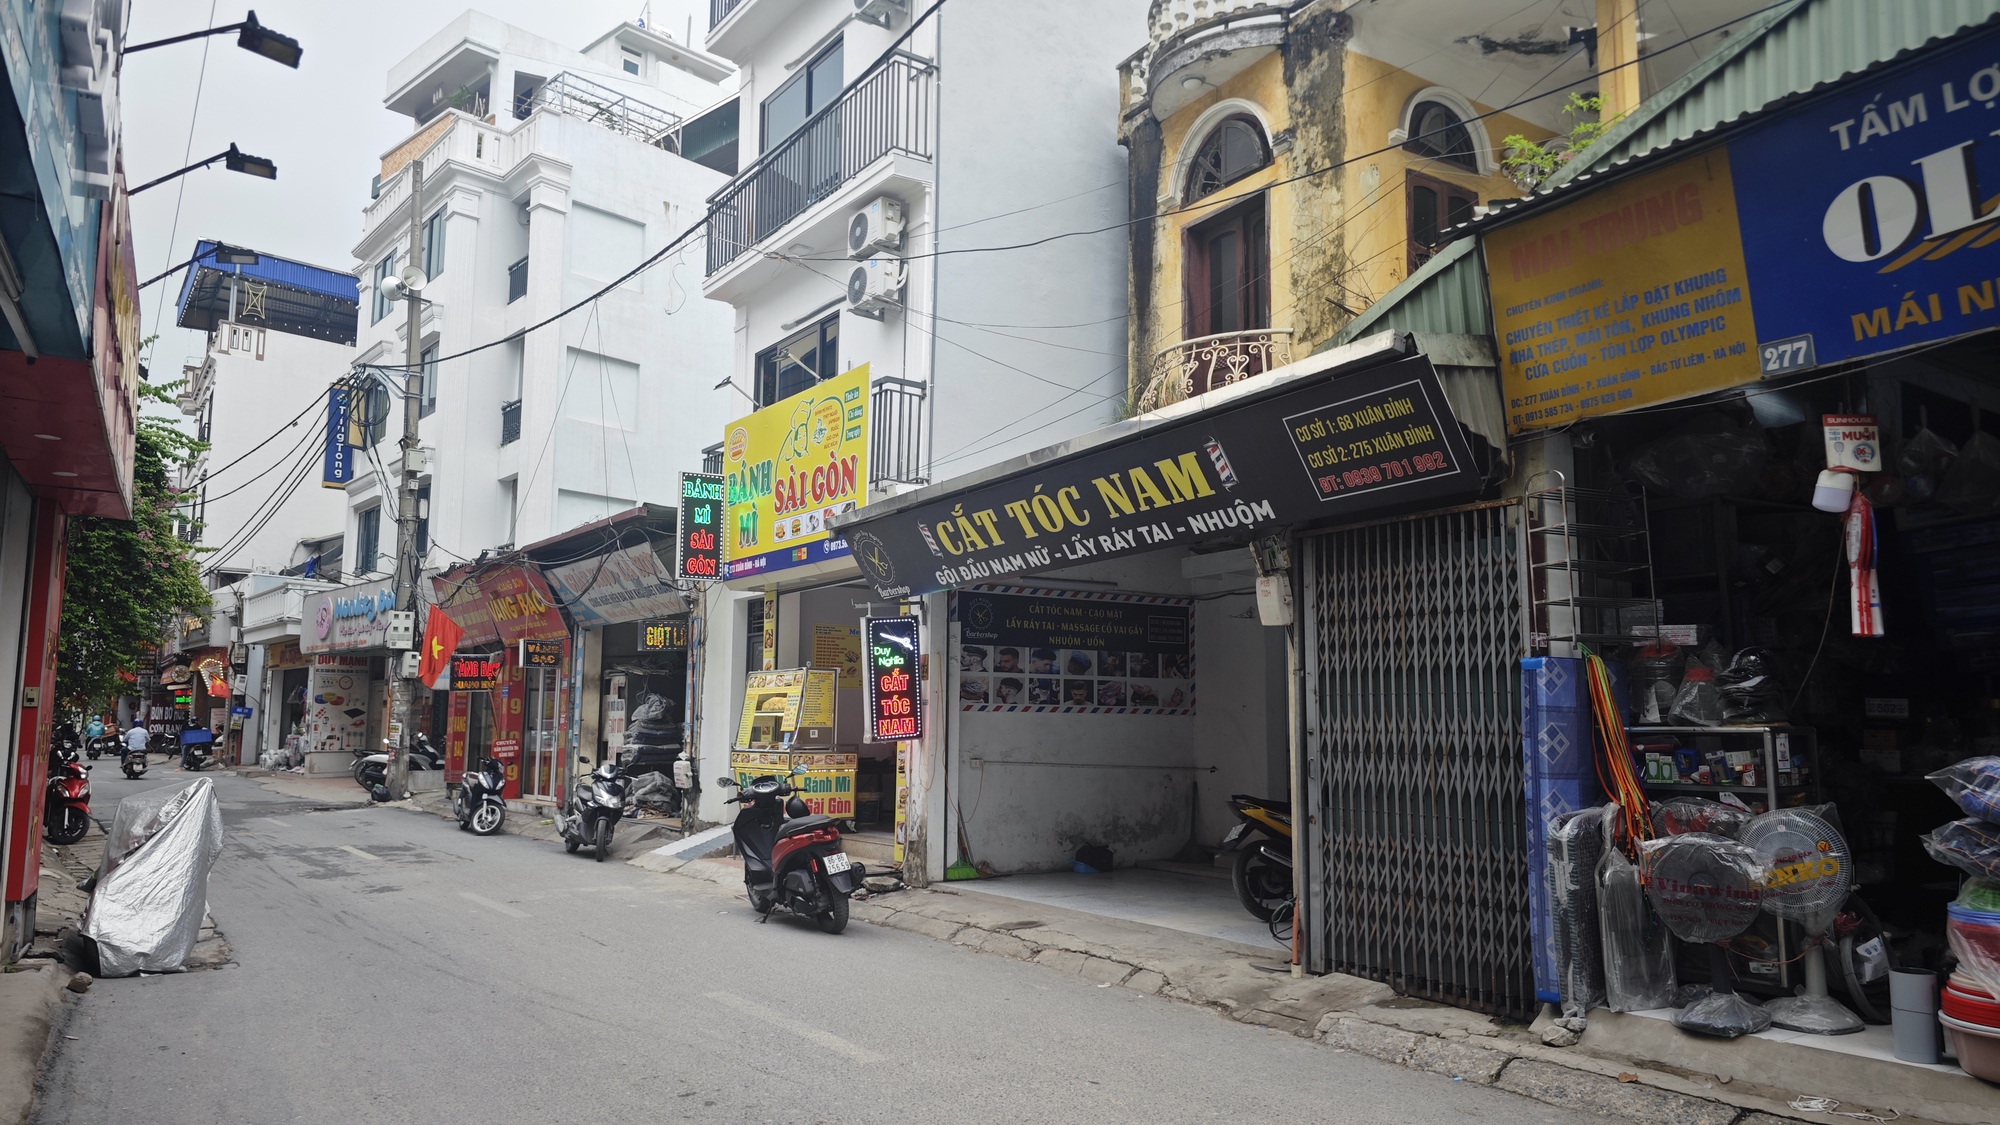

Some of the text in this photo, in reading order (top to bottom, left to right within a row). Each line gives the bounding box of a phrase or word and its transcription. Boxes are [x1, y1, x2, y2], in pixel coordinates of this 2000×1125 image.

[1829, 92, 1928, 151] TẤM
[1822, 131, 2000, 263] OL
[1510, 182, 1703, 283] MAI TRUNG
[1505, 268, 1727, 346] CHUYÊN THIẾT KẾ LẮP ĐẶT KHUNG
[1506, 277, 1605, 318] CHUYÊN KINH DOANH:
[1851, 278, 2000, 342] MÁI N
[1510, 340, 1534, 365] NHÀ
[1575, 320, 1601, 347] MÁI
[1641, 303, 1691, 329] KHUNG
[1694, 287, 1741, 314] NHÔM
[1525, 315, 1726, 381] CỬA CUỐN TÔN LỢP OLYMPIC
[1764, 341, 1807, 371] 277
[1524, 394, 1538, 407] 277
[1539, 386, 1560, 403] XUÂN
[1713, 345, 1727, 360] HÀ
[1728, 341, 1747, 356] NỘI
[1295, 397, 1415, 443] CƠ SỞ 1: 68 XUÂN ĐỈNH
[1307, 423, 1435, 469] CƠ SỞ 2: 275 XUÂN ĐỈNH
[1842, 428, 1876, 441] MUỖI
[727, 453, 773, 507] BÁNH
[774, 450, 859, 516] SÀI GÒN
[1318, 451, 1447, 494] ĐT: 0939 701 992
[684, 478, 723, 501] BÁNH
[694, 504, 711, 525] MÌ
[936, 451, 1216, 556] CẮT TÓC NAM
[739, 501, 759, 549] MÌ
[690, 529, 714, 551] SÀI
[960, 556, 991, 581] ĐẦU
[991, 555, 1027, 575] NAM
[1026, 547, 1052, 567] NỮ
[1062, 530, 1099, 561] LẤY
[1098, 524, 1138, 553] RÁY
[1137, 521, 1175, 545] TAI
[1189, 498, 1276, 535] NHUỘM
[686, 554, 716, 576] GÒN
[874, 584, 911, 599] Barbershop
[333, 591, 376, 622] Monkey
[486, 592, 519, 622] VÀNG
[516, 589, 546, 620] BẠC
[1029, 602, 1045, 614] CẮT
[1046, 604, 1062, 615] TÓC
[1063, 607, 1083, 617] NAM
[646, 623, 671, 648] GIẶT
[964, 628, 998, 640] Barbershop
[1006, 616, 1022, 628] LẤY
[1023, 619, 1041, 630] RÁY
[1042, 621, 1055, 631] TAI
[1061, 622, 1100, 633] MASSAGE
[1113, 626, 1127, 635] VAI
[873, 647, 891, 657] Duy
[1049, 635, 1105, 648] NHUỘM UỐN
[318, 654, 337, 666] DUY
[339, 655, 368, 668] MẠNH
[878, 656, 904, 667] Nghĩa
[880, 668, 909, 692] CẮT
[150, 703, 164, 720] BÚN
[164, 703, 173, 720] BÒ
[510, 697, 521, 714] 9
[881, 695, 911, 716] TÓC
[878, 717, 915, 736] NAM
[506, 763, 518, 781] 9
[803, 776, 851, 793] Bánh Mì
[805, 797, 851, 815] Sài Gòn
[1763, 857, 1839, 888] ENKO
[1657, 877, 1760, 900] Vinawind
